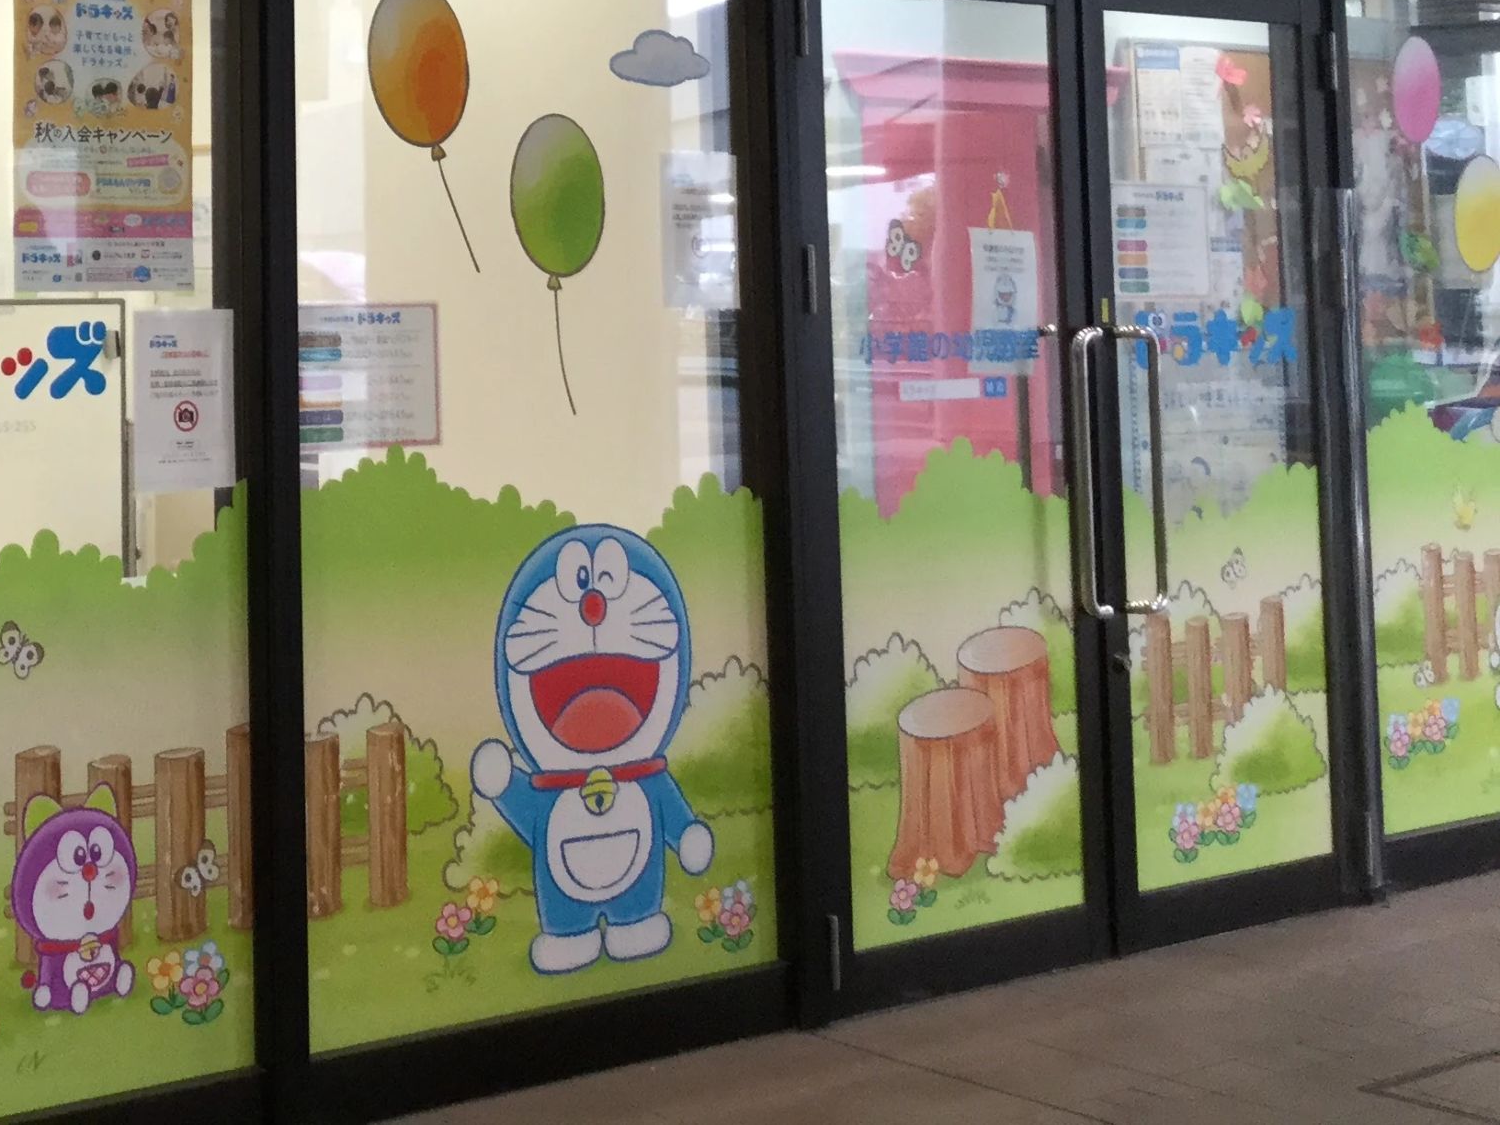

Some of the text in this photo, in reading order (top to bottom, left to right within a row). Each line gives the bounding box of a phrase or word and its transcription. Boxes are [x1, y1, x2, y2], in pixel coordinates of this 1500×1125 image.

[75, 2, 134, 21] ドラキッズ
[34, 121, 174, 145] 秋の入会キャンペーン
